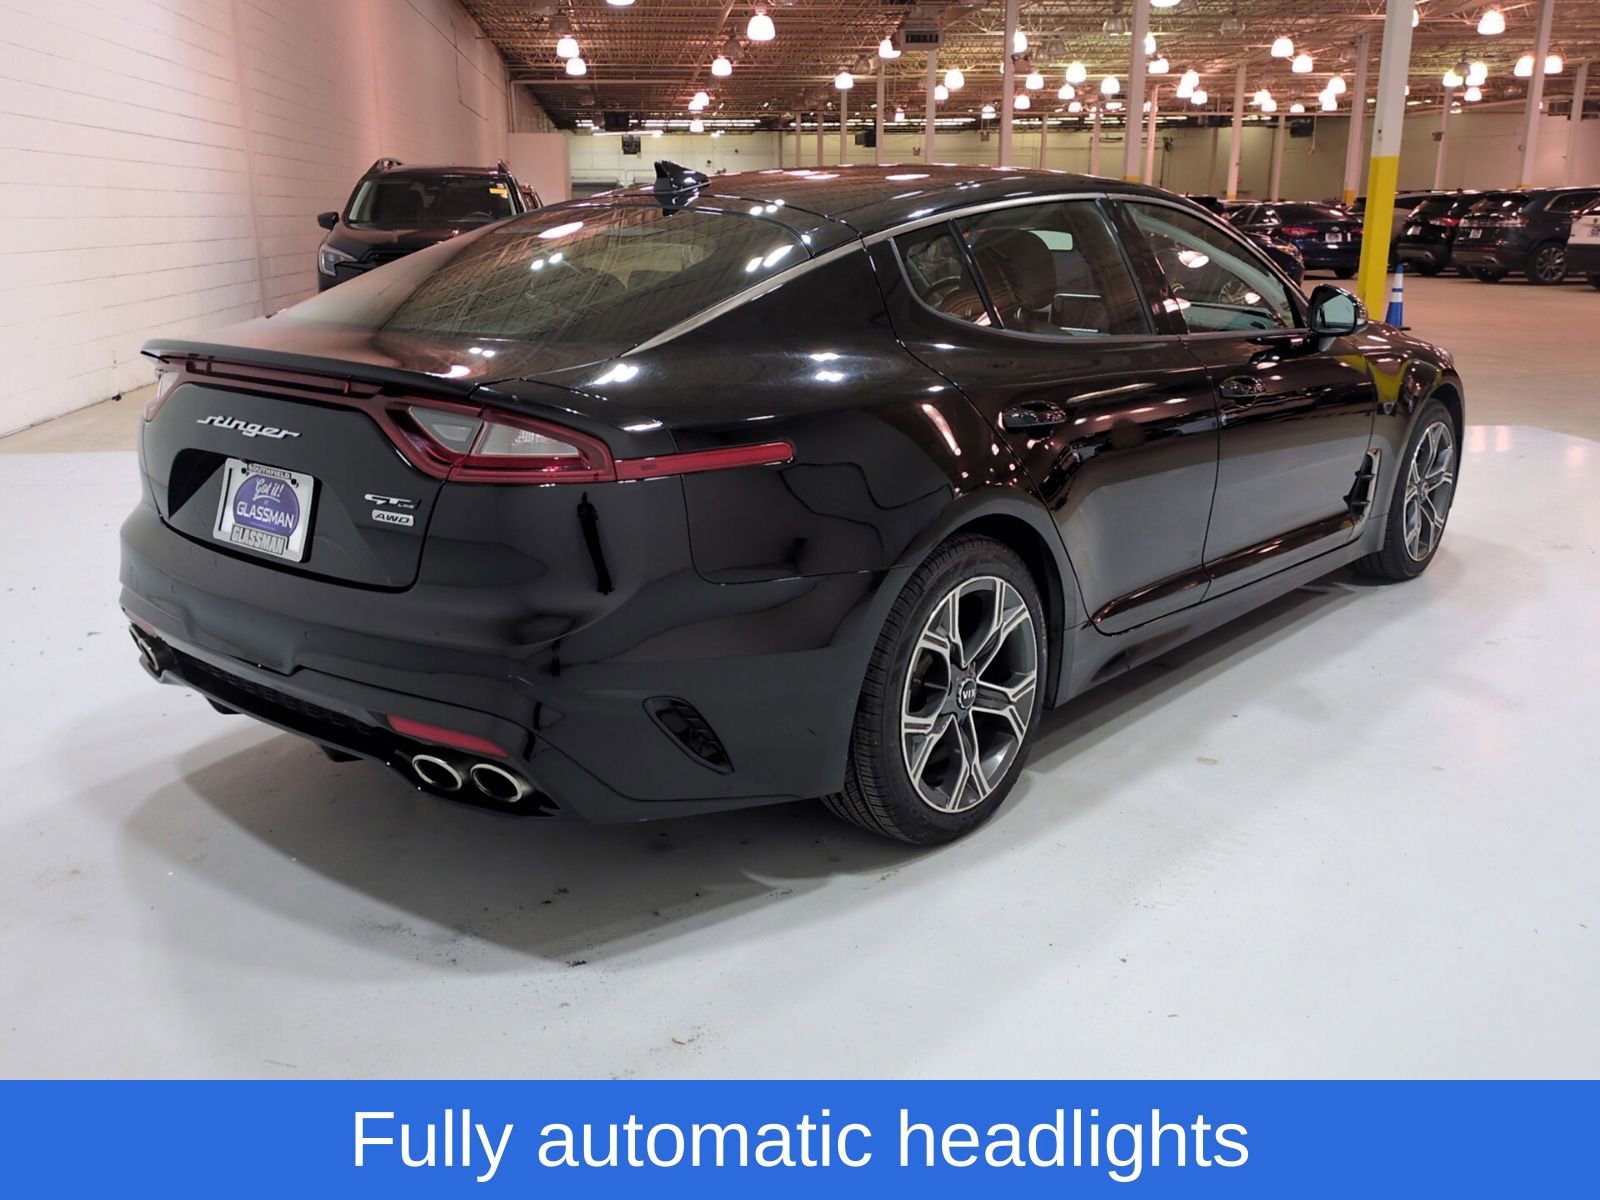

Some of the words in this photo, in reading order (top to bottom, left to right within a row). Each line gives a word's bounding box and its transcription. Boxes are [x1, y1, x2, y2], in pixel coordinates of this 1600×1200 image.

[196, 415, 300, 439] stinger
[247, 463, 292, 480] SOUTHFIELD
[254, 477, 271, 495] Got
[236, 501, 294, 529] GLASSMAN
[375, 512, 410, 523] AWD
[231, 525, 285, 555] GLASSMAN
